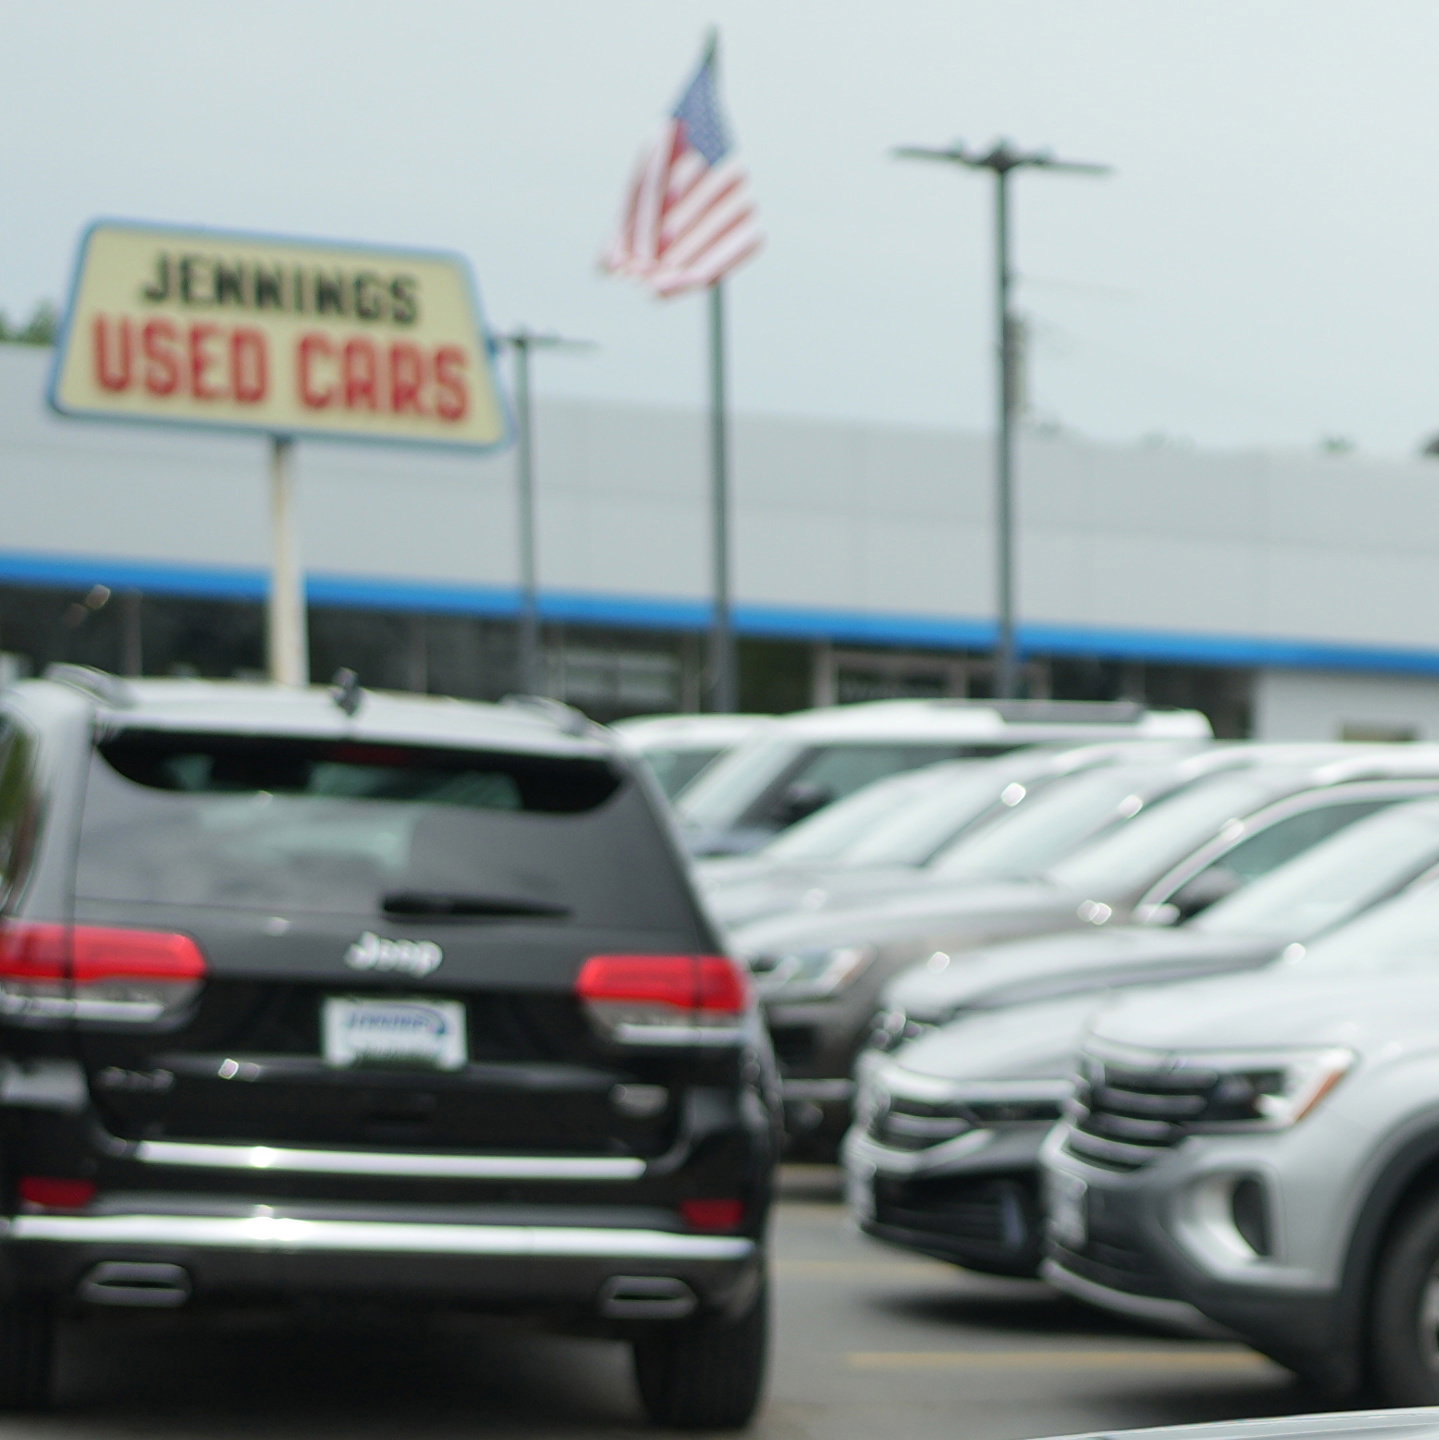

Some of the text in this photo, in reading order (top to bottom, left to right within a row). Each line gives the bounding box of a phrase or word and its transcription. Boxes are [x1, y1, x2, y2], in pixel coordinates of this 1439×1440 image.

[142, 253, 418, 325] JENNINGS
[92, 312, 469, 422] USED CARS
[343, 931, 442, 978] Jeep
